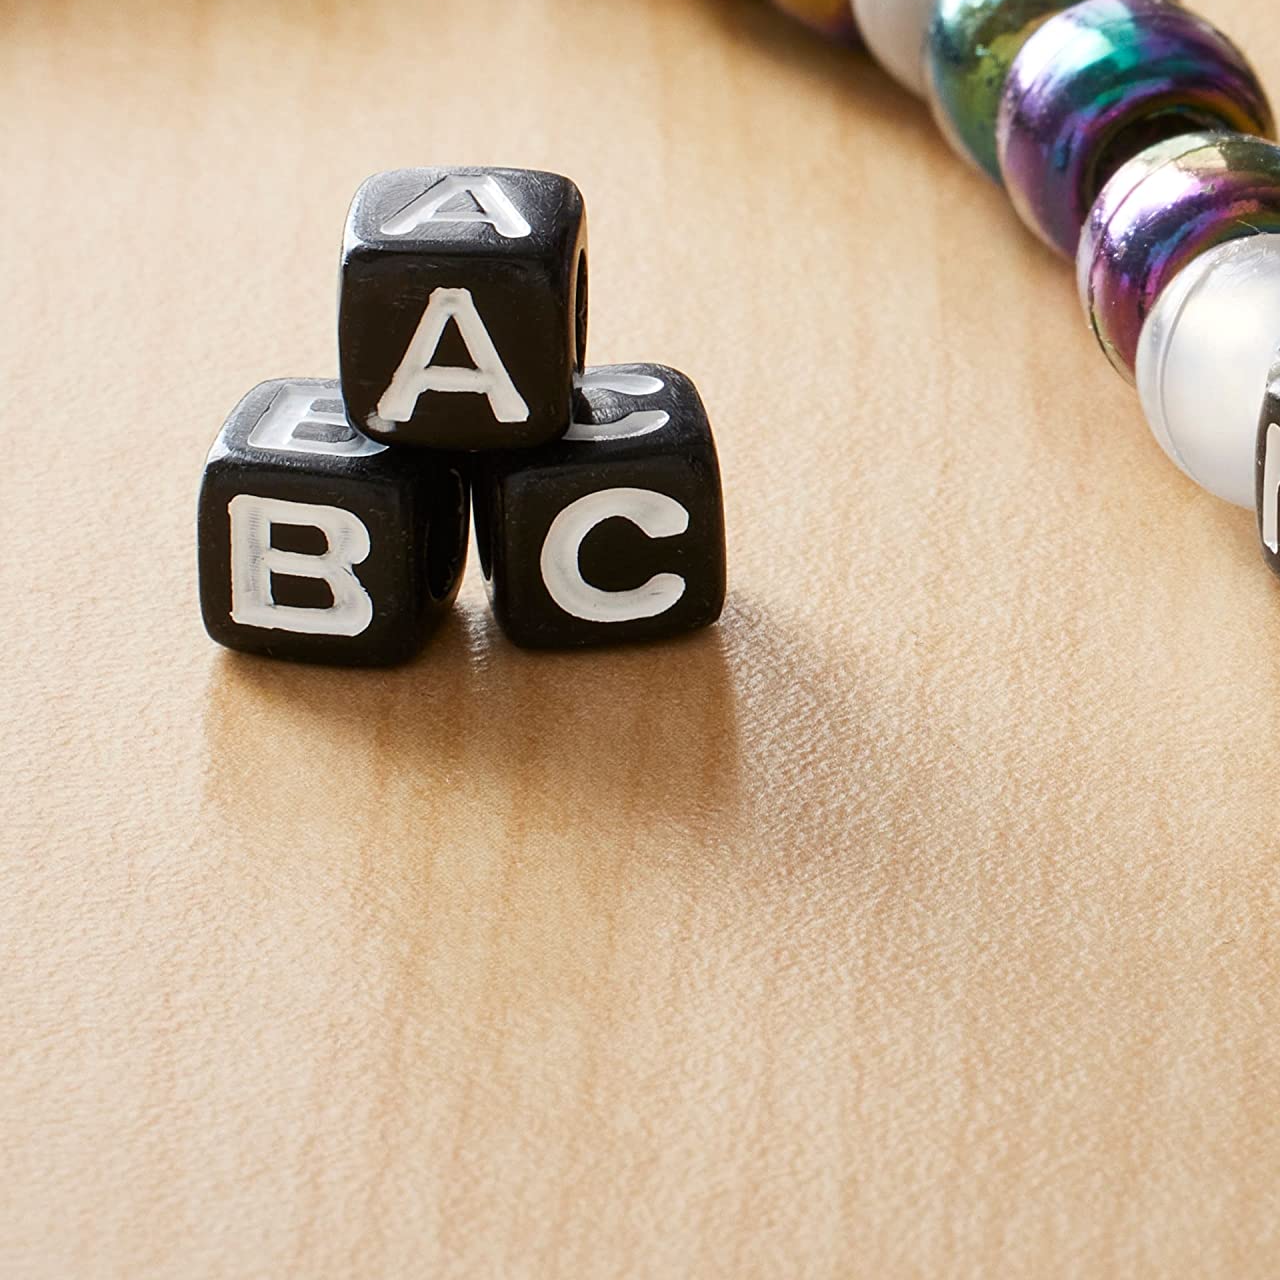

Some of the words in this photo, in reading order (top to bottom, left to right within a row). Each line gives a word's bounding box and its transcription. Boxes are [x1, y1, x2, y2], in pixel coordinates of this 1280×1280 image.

[380, 174, 532, 238] A
[374, 287, 530, 423] A
[228, 494, 373, 637] B
[540, 487, 690, 623] C
